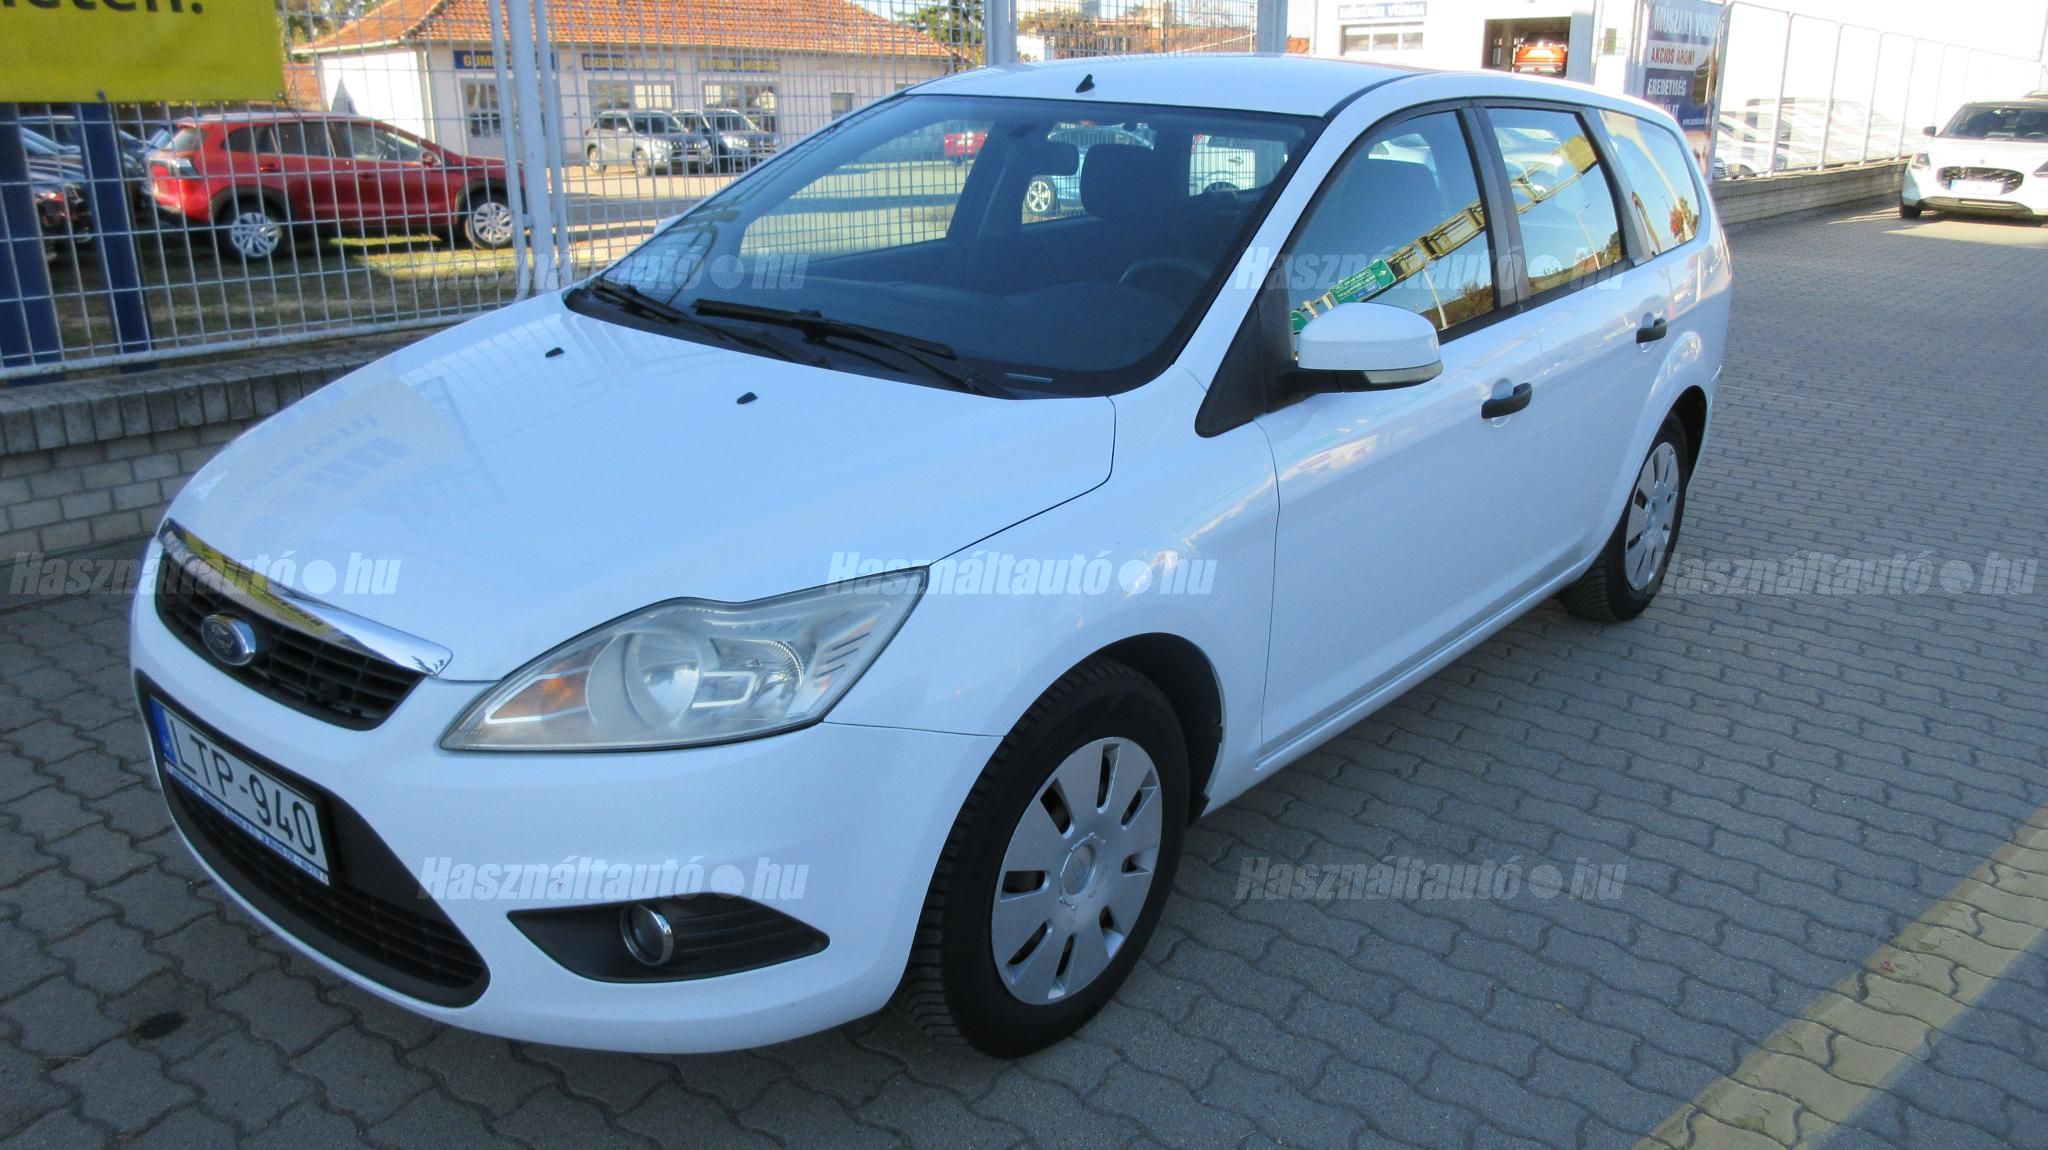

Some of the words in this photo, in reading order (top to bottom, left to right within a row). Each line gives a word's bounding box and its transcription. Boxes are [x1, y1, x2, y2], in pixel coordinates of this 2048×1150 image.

[1651, 43, 1675, 65] AKCIÓS
[1647, 76, 1687, 97] EREDETISÉG
[170, 719, 317, 856] LTP-940
